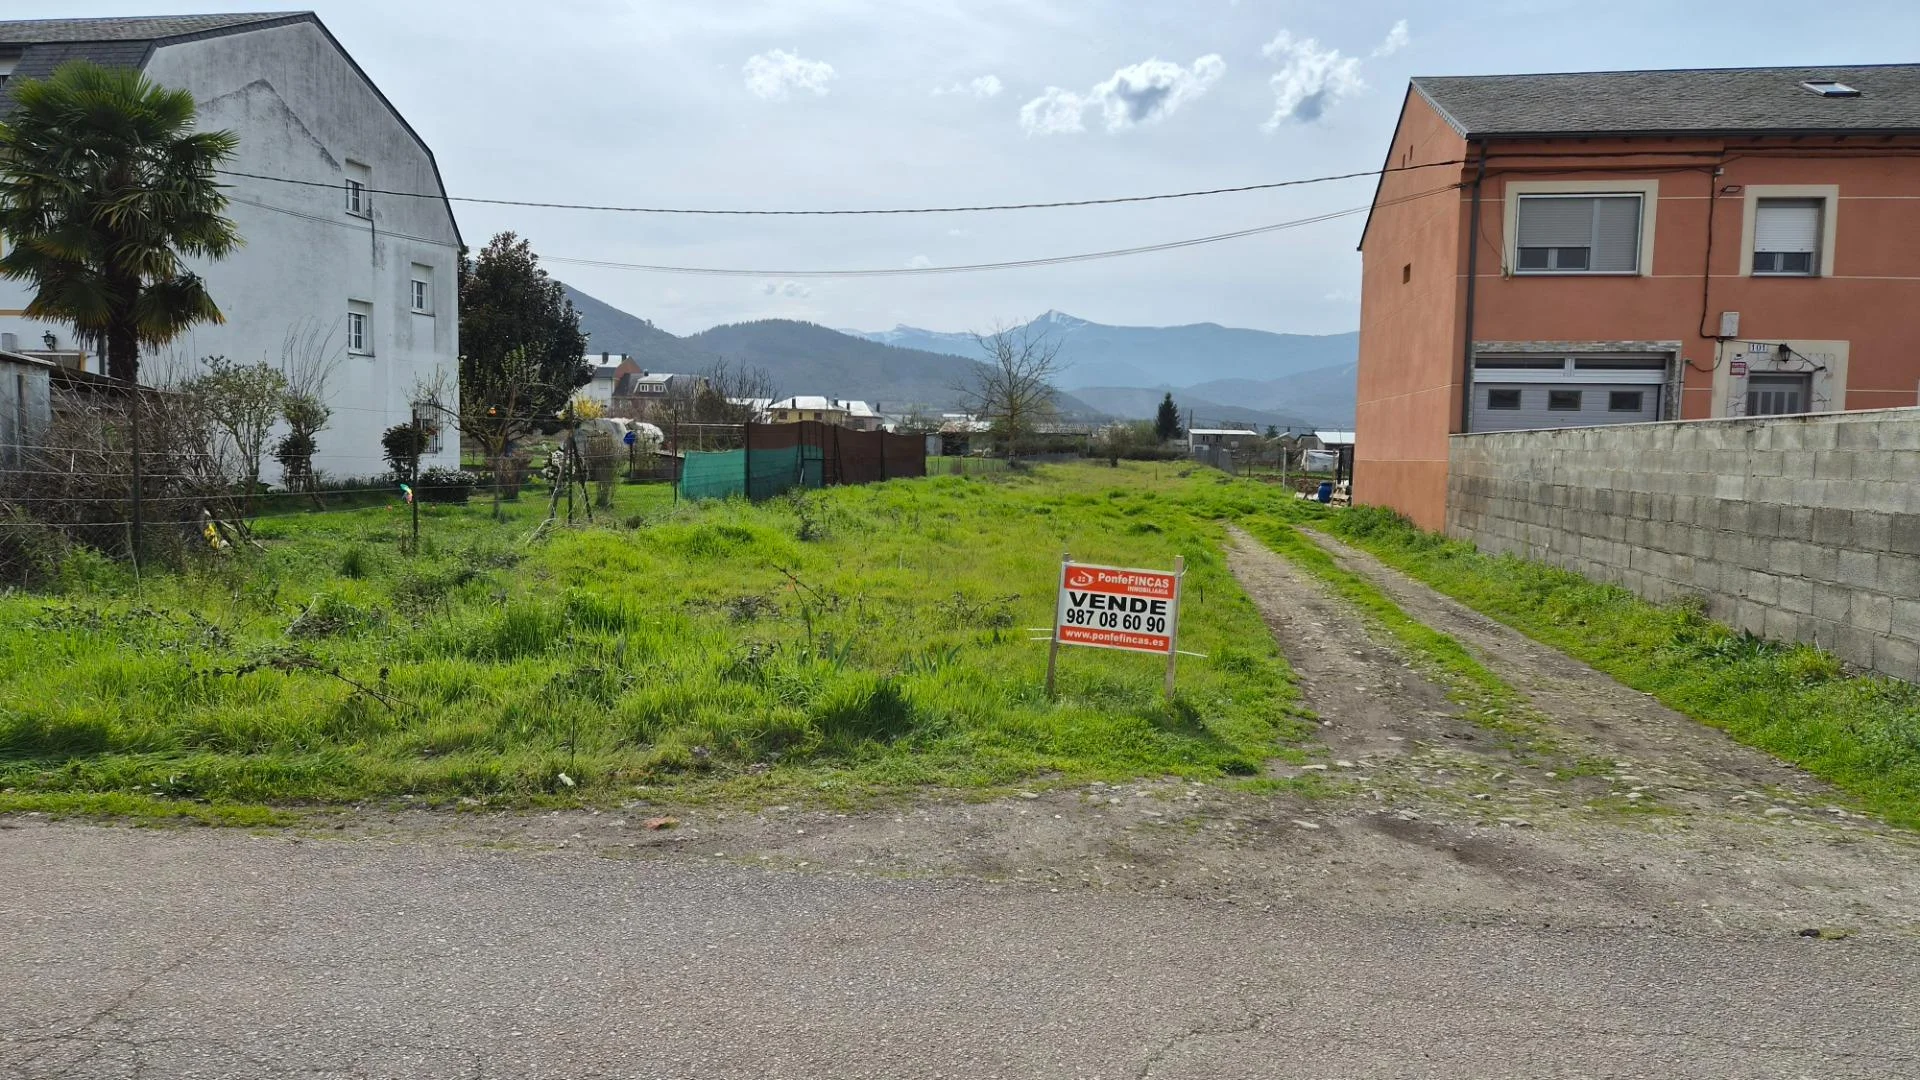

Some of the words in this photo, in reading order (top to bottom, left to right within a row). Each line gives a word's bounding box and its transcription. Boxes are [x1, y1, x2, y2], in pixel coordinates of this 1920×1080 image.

[1098, 572, 1169, 588] PonfeFINCAS
[1069, 591, 1167, 616] VENDE
[1066, 608, 1095, 626] 987
[1098, 611, 1118, 628] 08
[1122, 614, 1142, 631] 60
[1146, 616, 1165, 633] 90
[1065, 629, 1164, 647] www.ponfefincas.es
